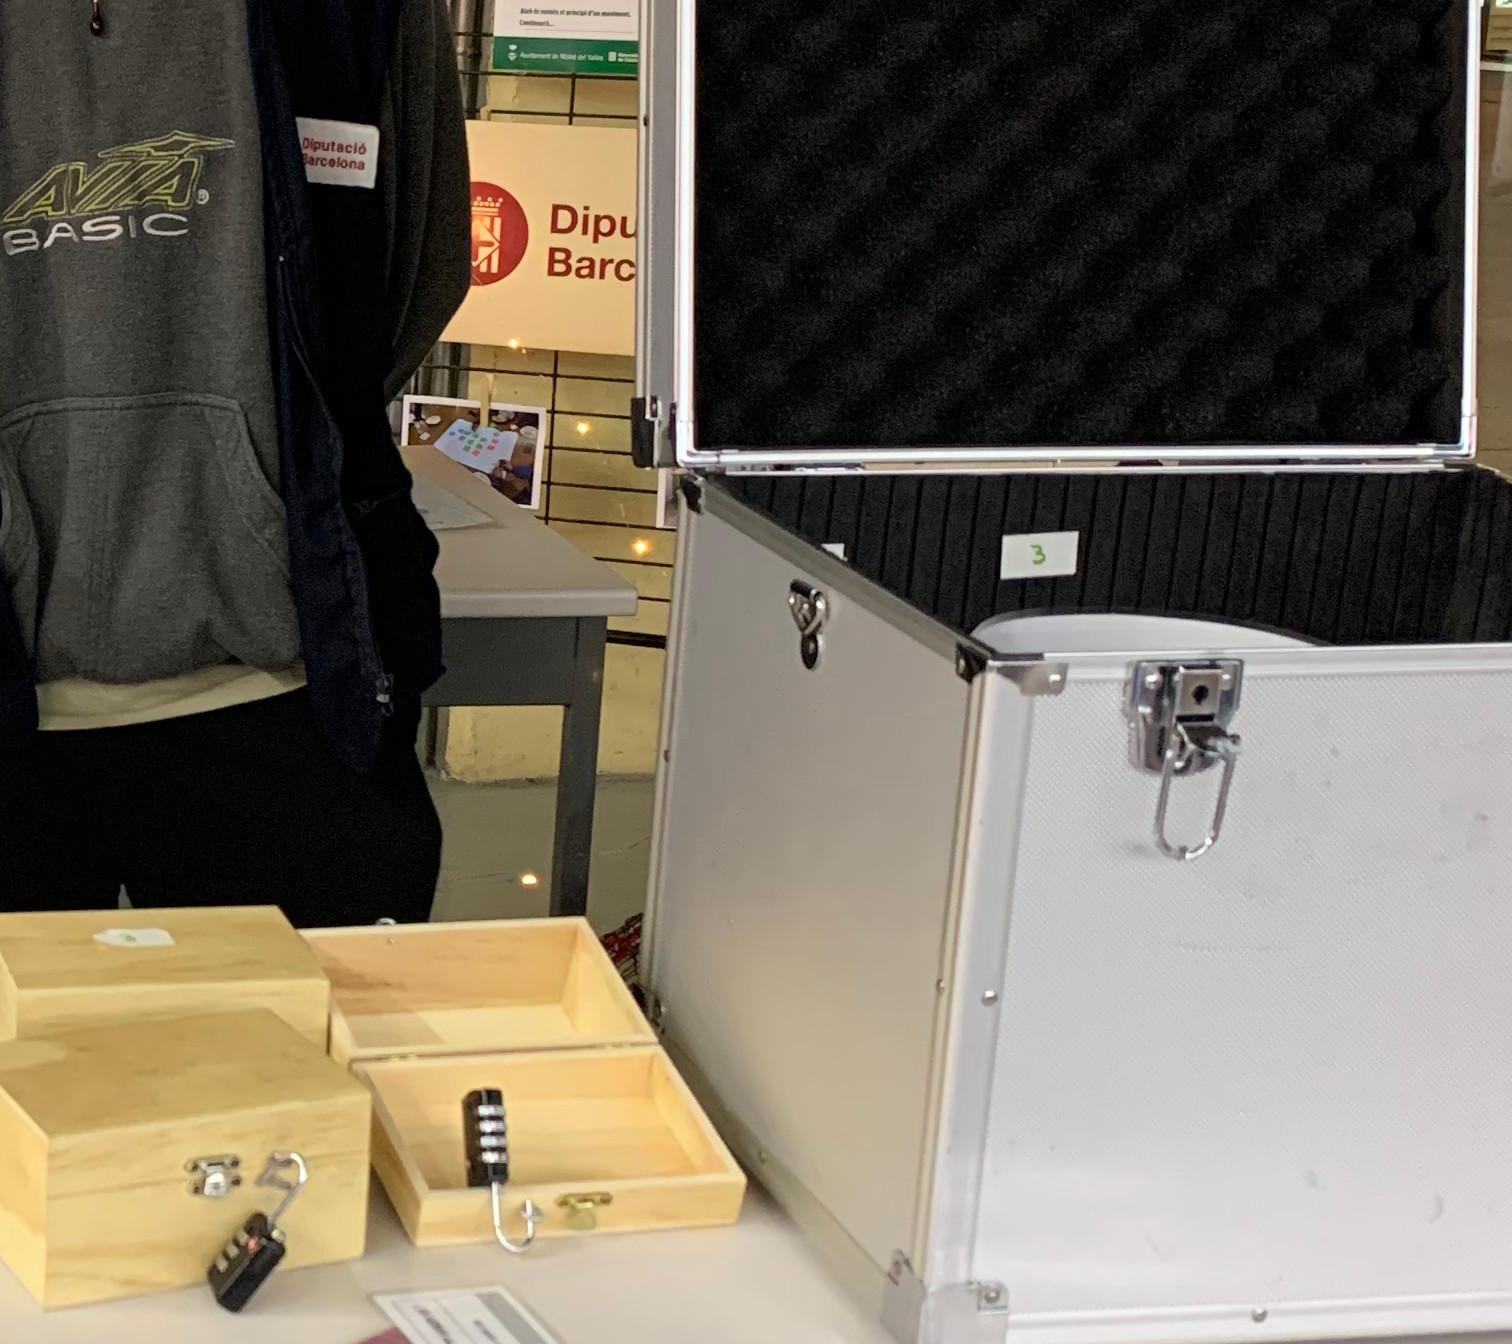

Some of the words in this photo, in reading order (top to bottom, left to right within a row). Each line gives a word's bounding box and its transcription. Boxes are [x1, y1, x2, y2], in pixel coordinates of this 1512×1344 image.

[303, 137, 367, 155] Diputació
[3, 213, 191, 256] BASIC
[1030, 544, 1046, 565] 3
